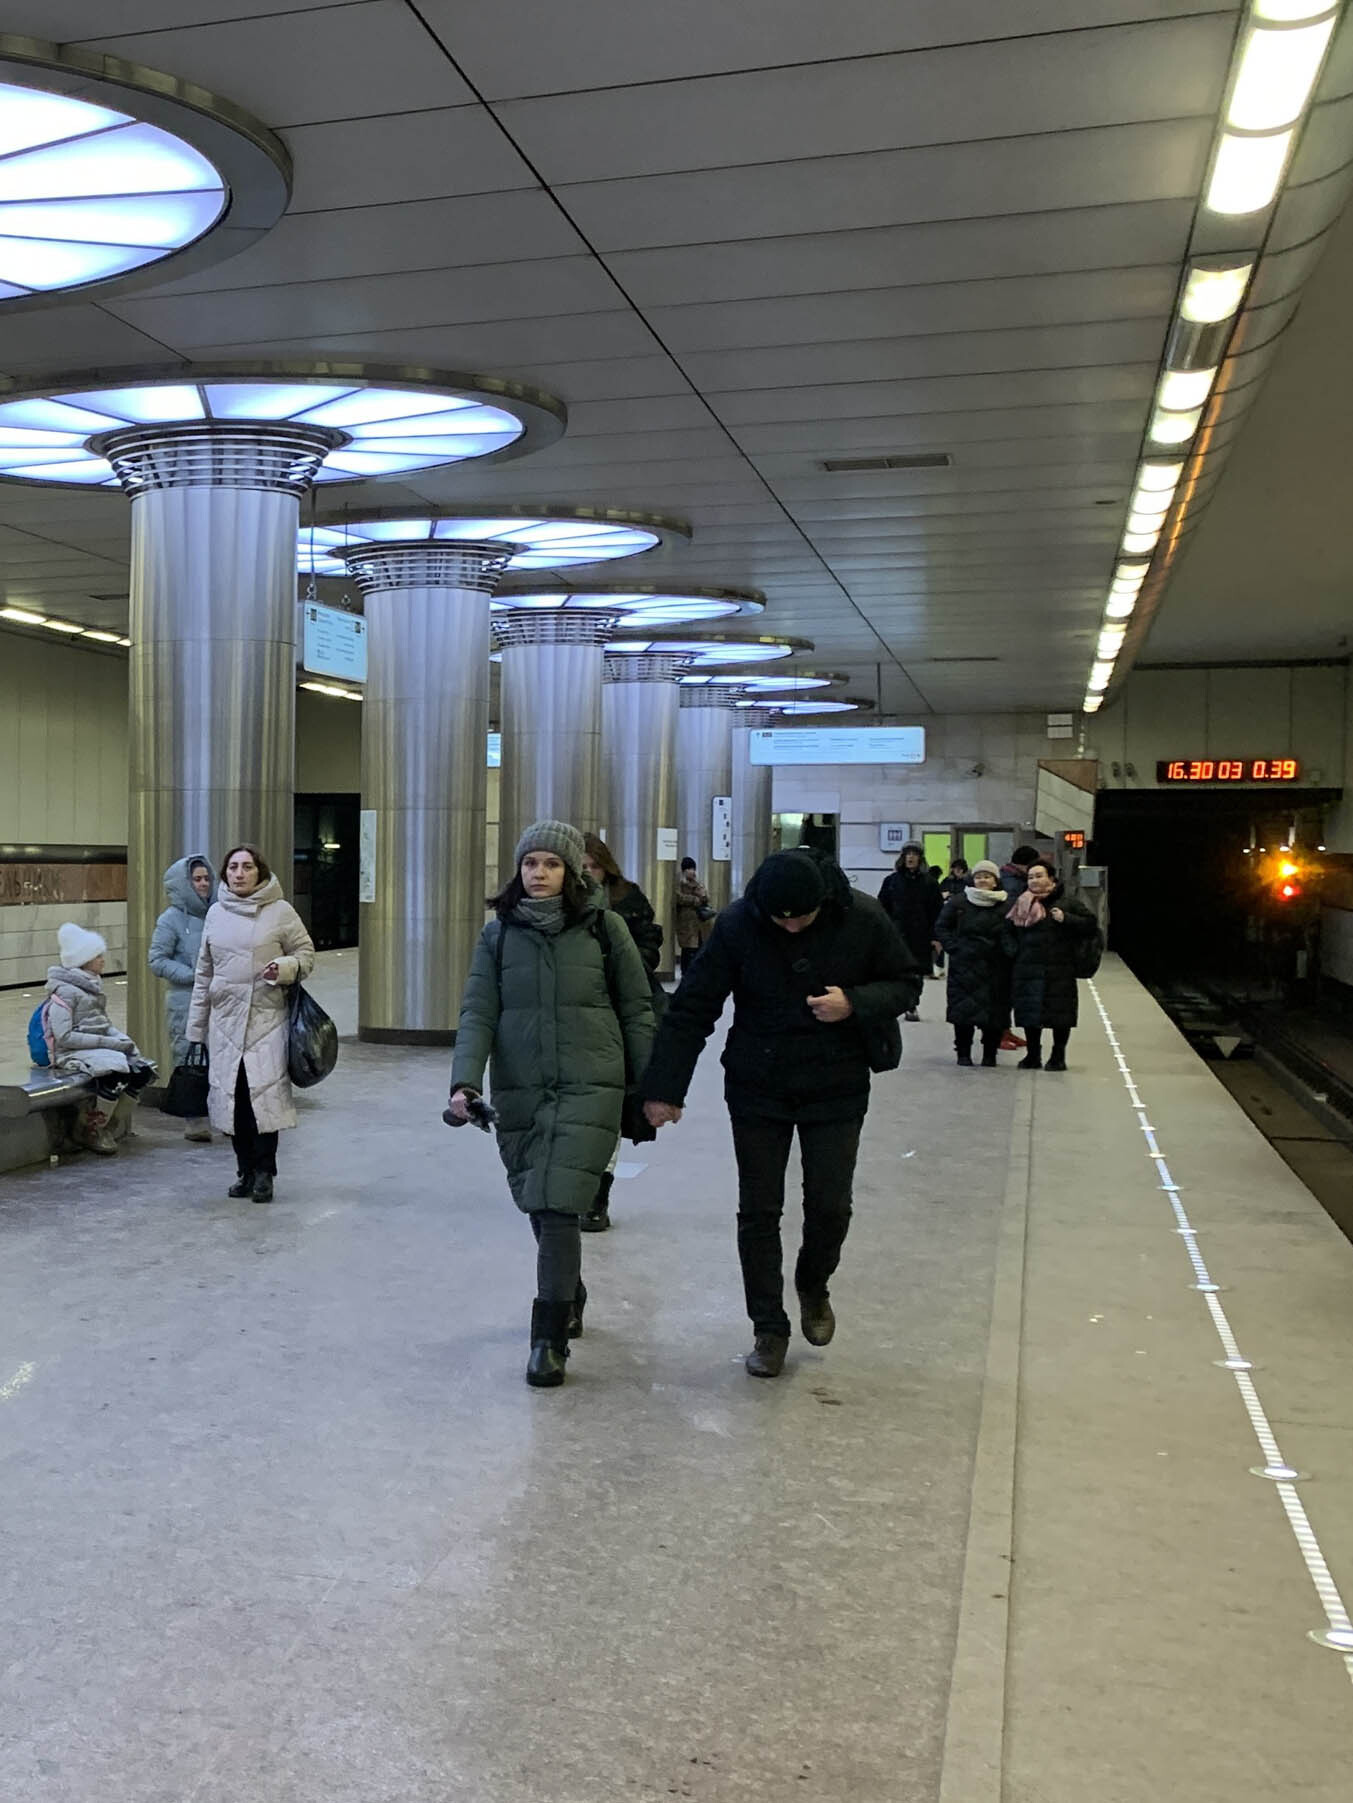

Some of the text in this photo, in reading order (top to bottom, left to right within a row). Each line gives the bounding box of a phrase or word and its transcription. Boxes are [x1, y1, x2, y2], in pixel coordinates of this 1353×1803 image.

[1168, 761, 1242, 780] 16.30 03
[1253, 760, 1296, 779] 0.39
